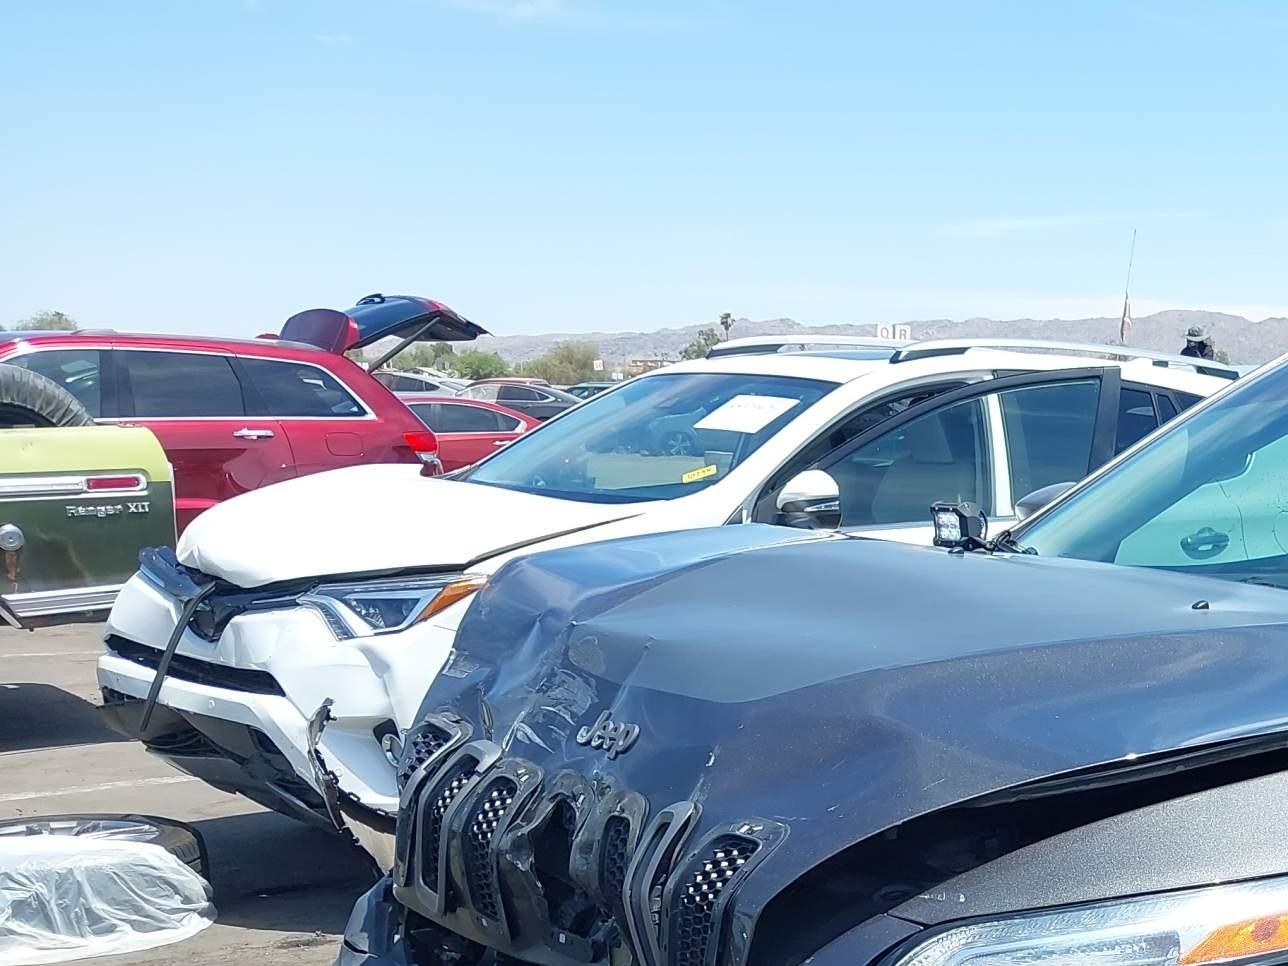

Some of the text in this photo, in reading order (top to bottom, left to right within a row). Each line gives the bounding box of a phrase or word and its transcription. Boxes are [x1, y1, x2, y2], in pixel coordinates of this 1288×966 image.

[66, 502, 150, 517] Ranger XLT
[576, 710, 640, 760] Jeep
